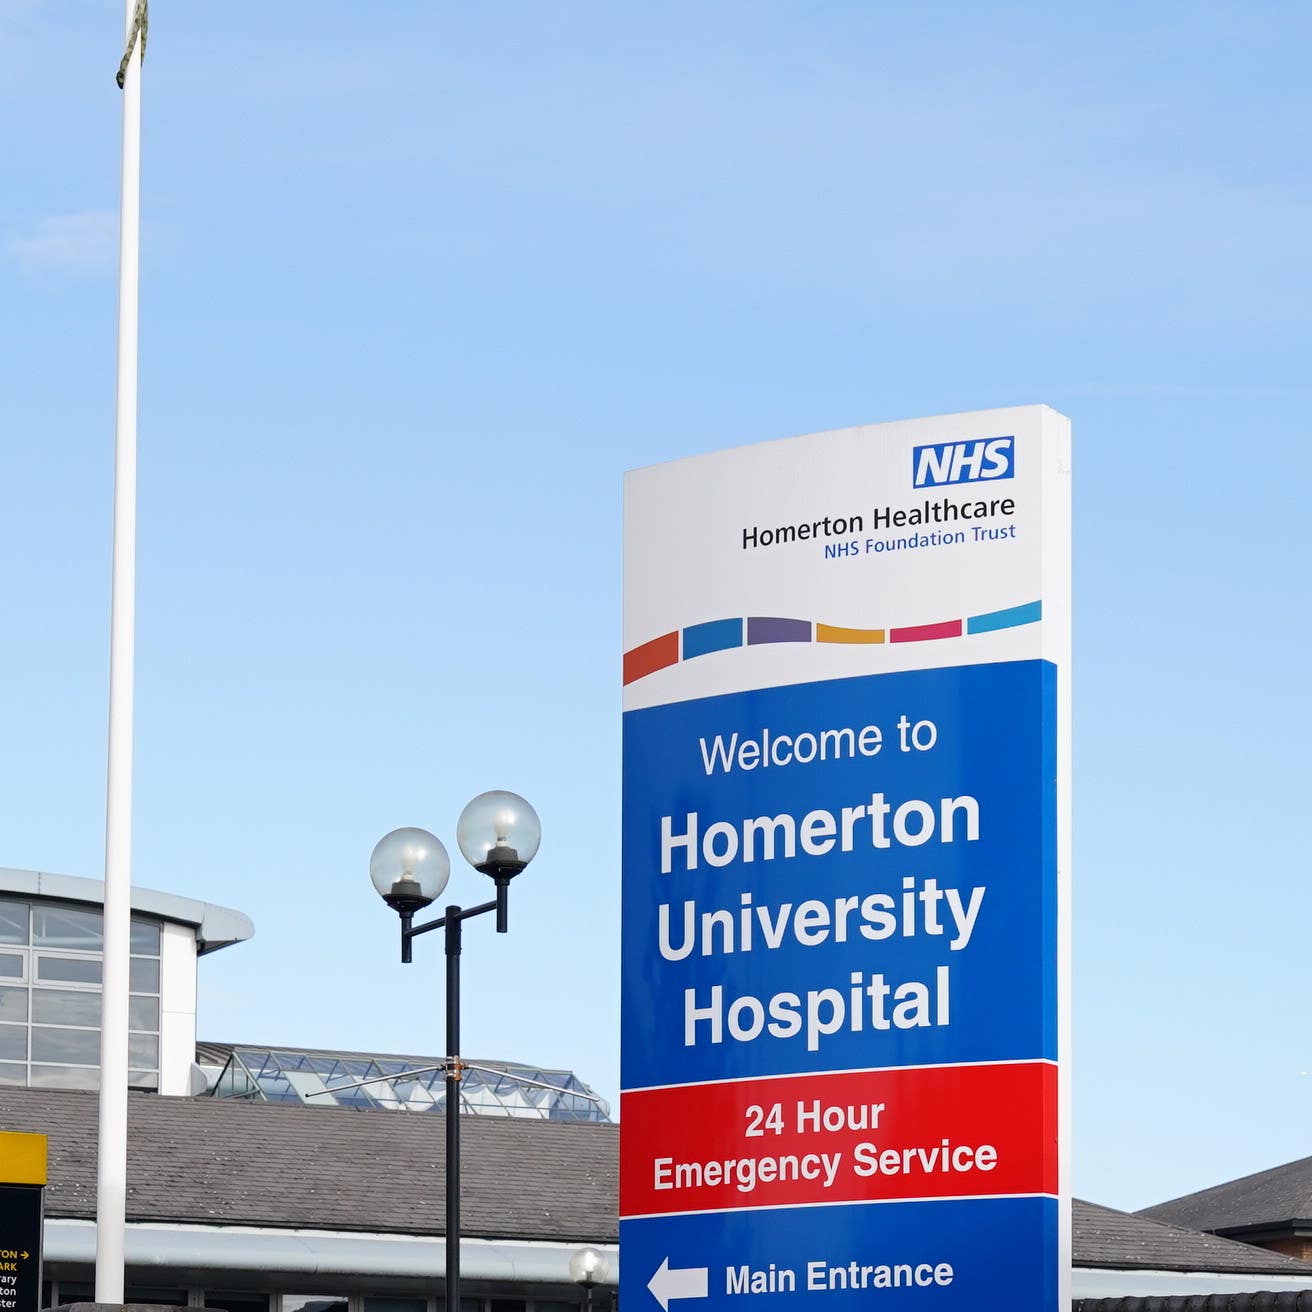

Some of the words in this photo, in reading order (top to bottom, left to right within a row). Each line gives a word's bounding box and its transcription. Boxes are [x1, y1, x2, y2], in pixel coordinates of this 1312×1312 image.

[915, 439, 1012, 486] NHS
[743, 512, 863, 549] Homerton
[873, 498, 1015, 530] Healthcare
[824, 542, 859, 559] NHS
[866, 529, 965, 554] Foundation
[972, 524, 1016, 542] Trust
[699, 726, 882, 775] Welcome
[897, 715, 937, 753] to
[660, 792, 980, 874] Homerton
[658, 876, 986, 962] University
[684, 966, 950, 1051] Hospital
[745, 1103, 784, 1137] 24
[797, 1099, 886, 1133] Hour
[654, 1151, 842, 1192] Emergency
[854, 1139, 997, 1177] Service
[726, 1265, 795, 1295] Main
[808, 1260, 954, 1291] Entrance
